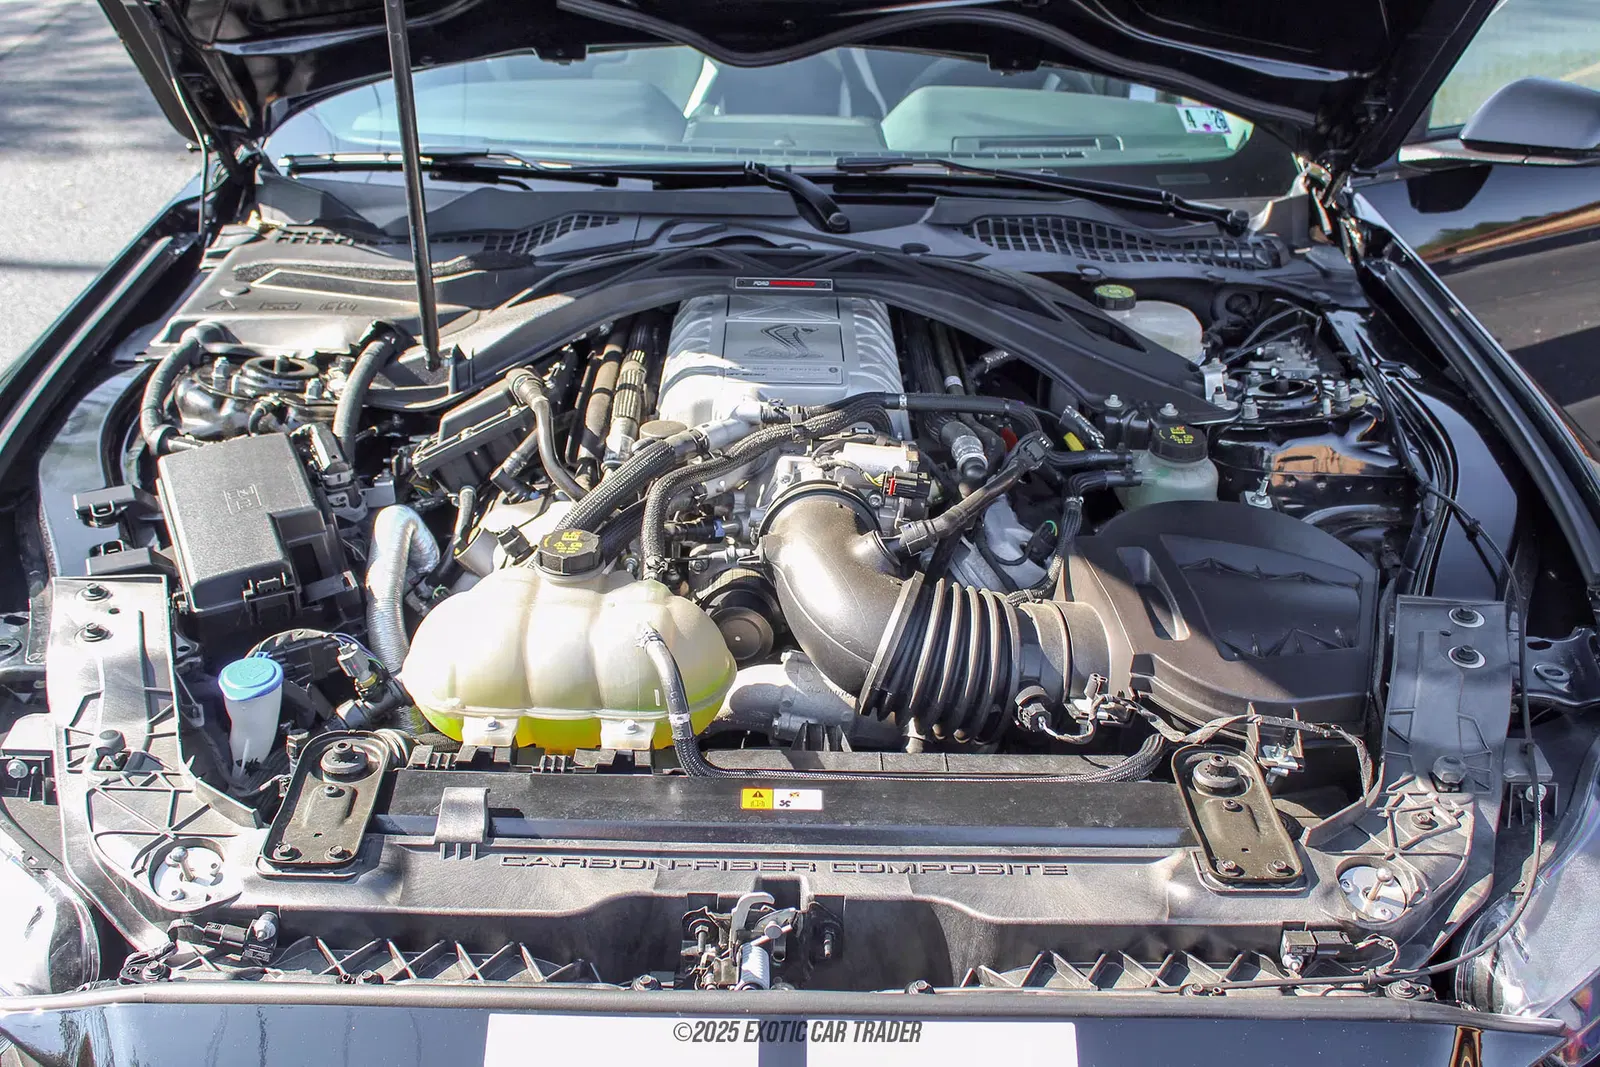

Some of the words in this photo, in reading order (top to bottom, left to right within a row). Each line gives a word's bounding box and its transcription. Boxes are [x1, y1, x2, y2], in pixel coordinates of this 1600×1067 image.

[1185, 110, 1197, 128] 4
[500, 855, 817, 873] CARBON-FIBER
[830, 861, 1069, 876] COMPOSITE
